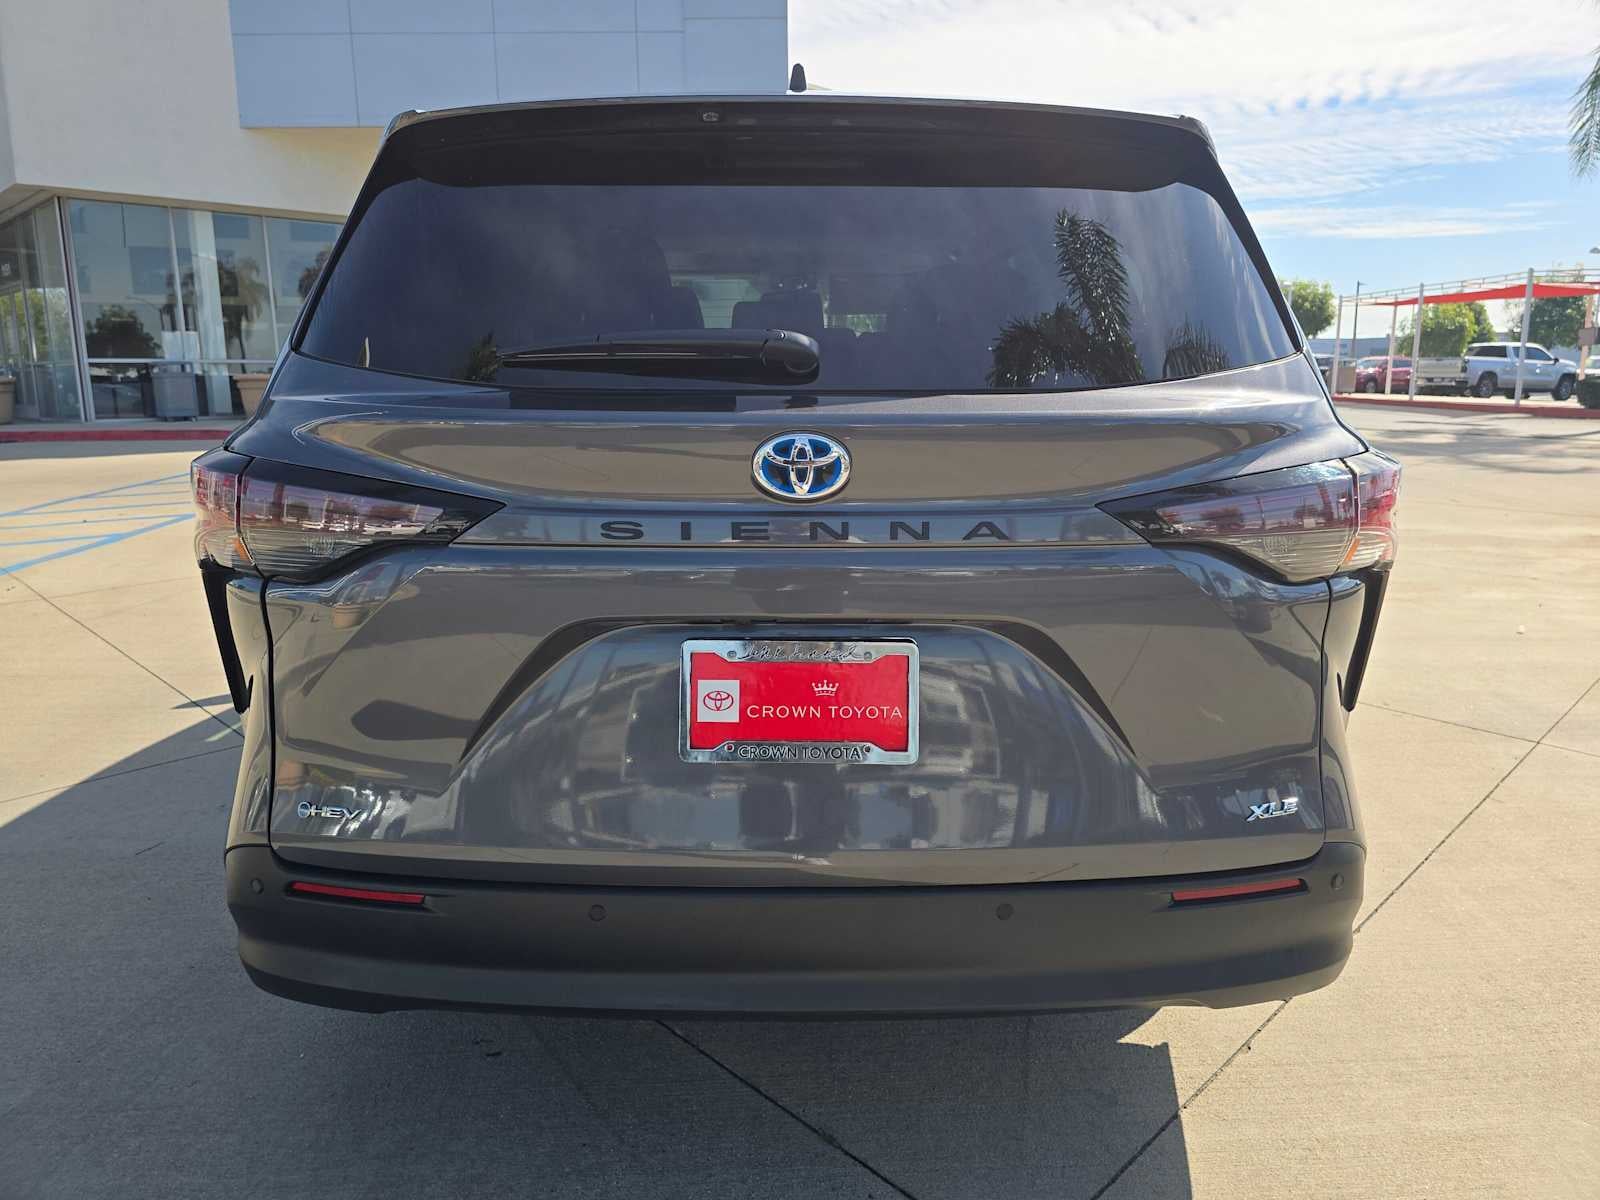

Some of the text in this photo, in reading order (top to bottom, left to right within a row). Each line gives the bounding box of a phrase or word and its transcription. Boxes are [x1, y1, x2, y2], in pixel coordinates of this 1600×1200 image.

[600, 520, 1009, 541] SIENNA
[746, 705, 903, 719] CROWN TOYOTA
[738, 745, 863, 760] CROWN TOYOTA
[311, 804, 362, 819] HEV
[1246, 797, 1299, 822] XLE
